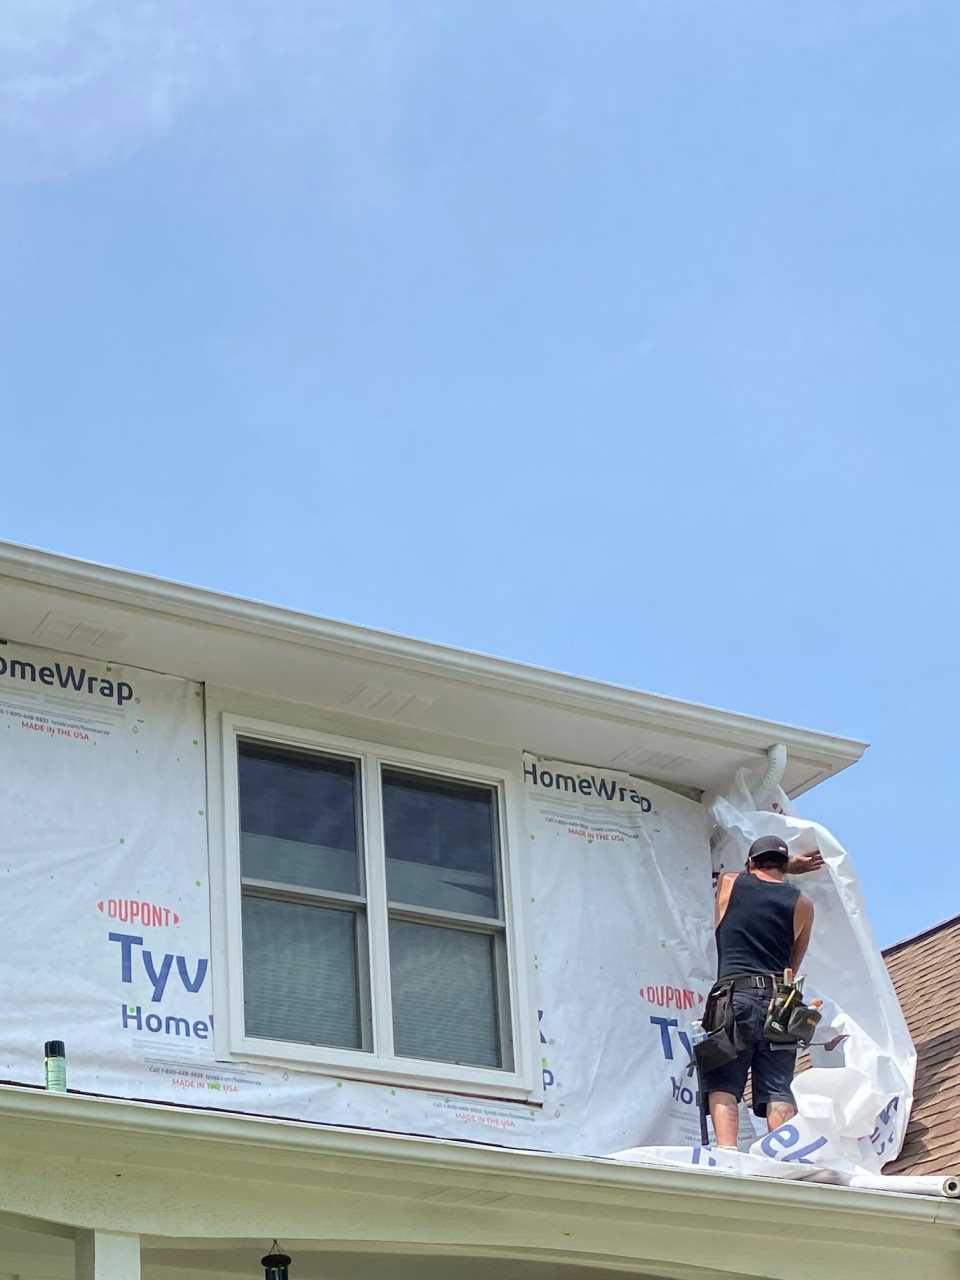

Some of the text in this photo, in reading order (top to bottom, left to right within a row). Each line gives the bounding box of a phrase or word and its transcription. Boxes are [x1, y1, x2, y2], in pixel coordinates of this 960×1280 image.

[21, 721, 90, 740] MADE IN THE USA
[567, 828, 586, 838] MADE
[596, 833, 609, 841] THE
[108, 899, 171, 927] DUPONT
[108, 931, 209, 1003] Tyv
[647, 986, 695, 1010] DUPONT
[172, 1078, 195, 1088] MADE
[223, 1084, 239, 1093] USA
[455, 1112, 516, 1127] MADE IN THE USA
